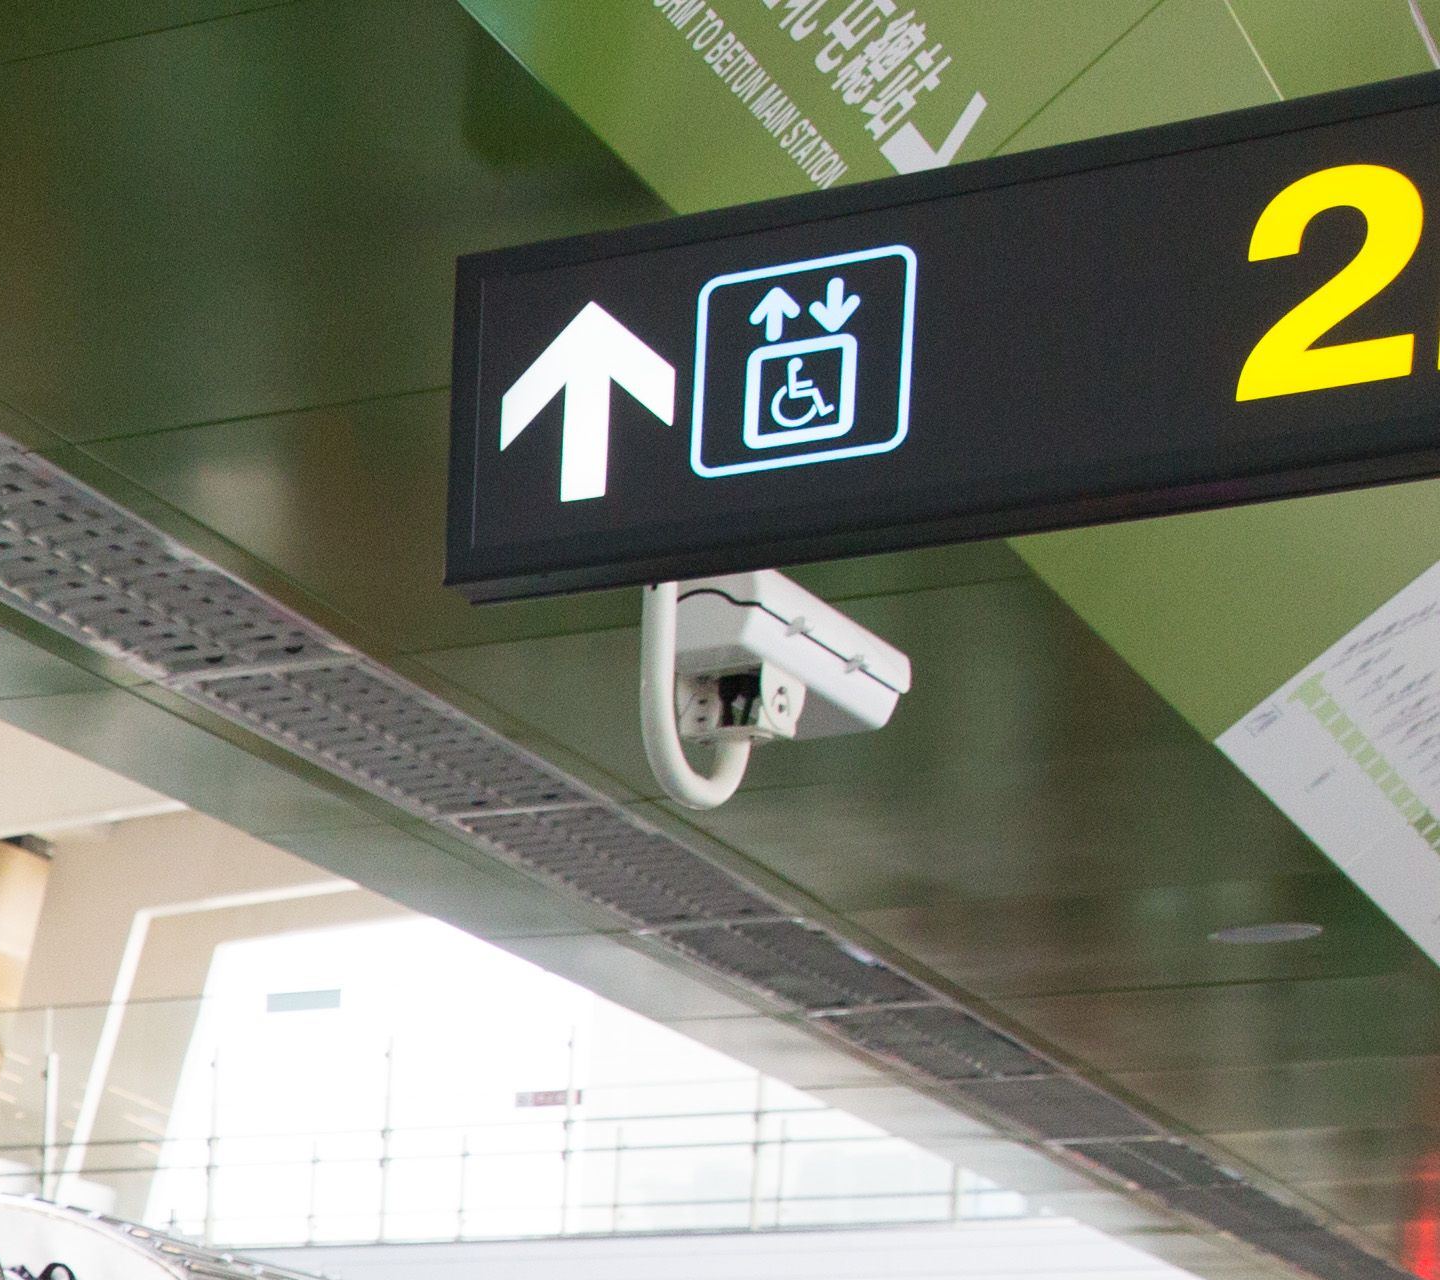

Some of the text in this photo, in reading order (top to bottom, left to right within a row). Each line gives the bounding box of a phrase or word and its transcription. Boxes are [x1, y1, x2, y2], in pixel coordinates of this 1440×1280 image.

[685, 7, 724, 51] TO
[703, 31, 772, 103] BEITUN
[763, 0, 952, 140] 屯總站
[749, 84, 801, 138] MAIN
[780, 118, 848, 189] STATION
